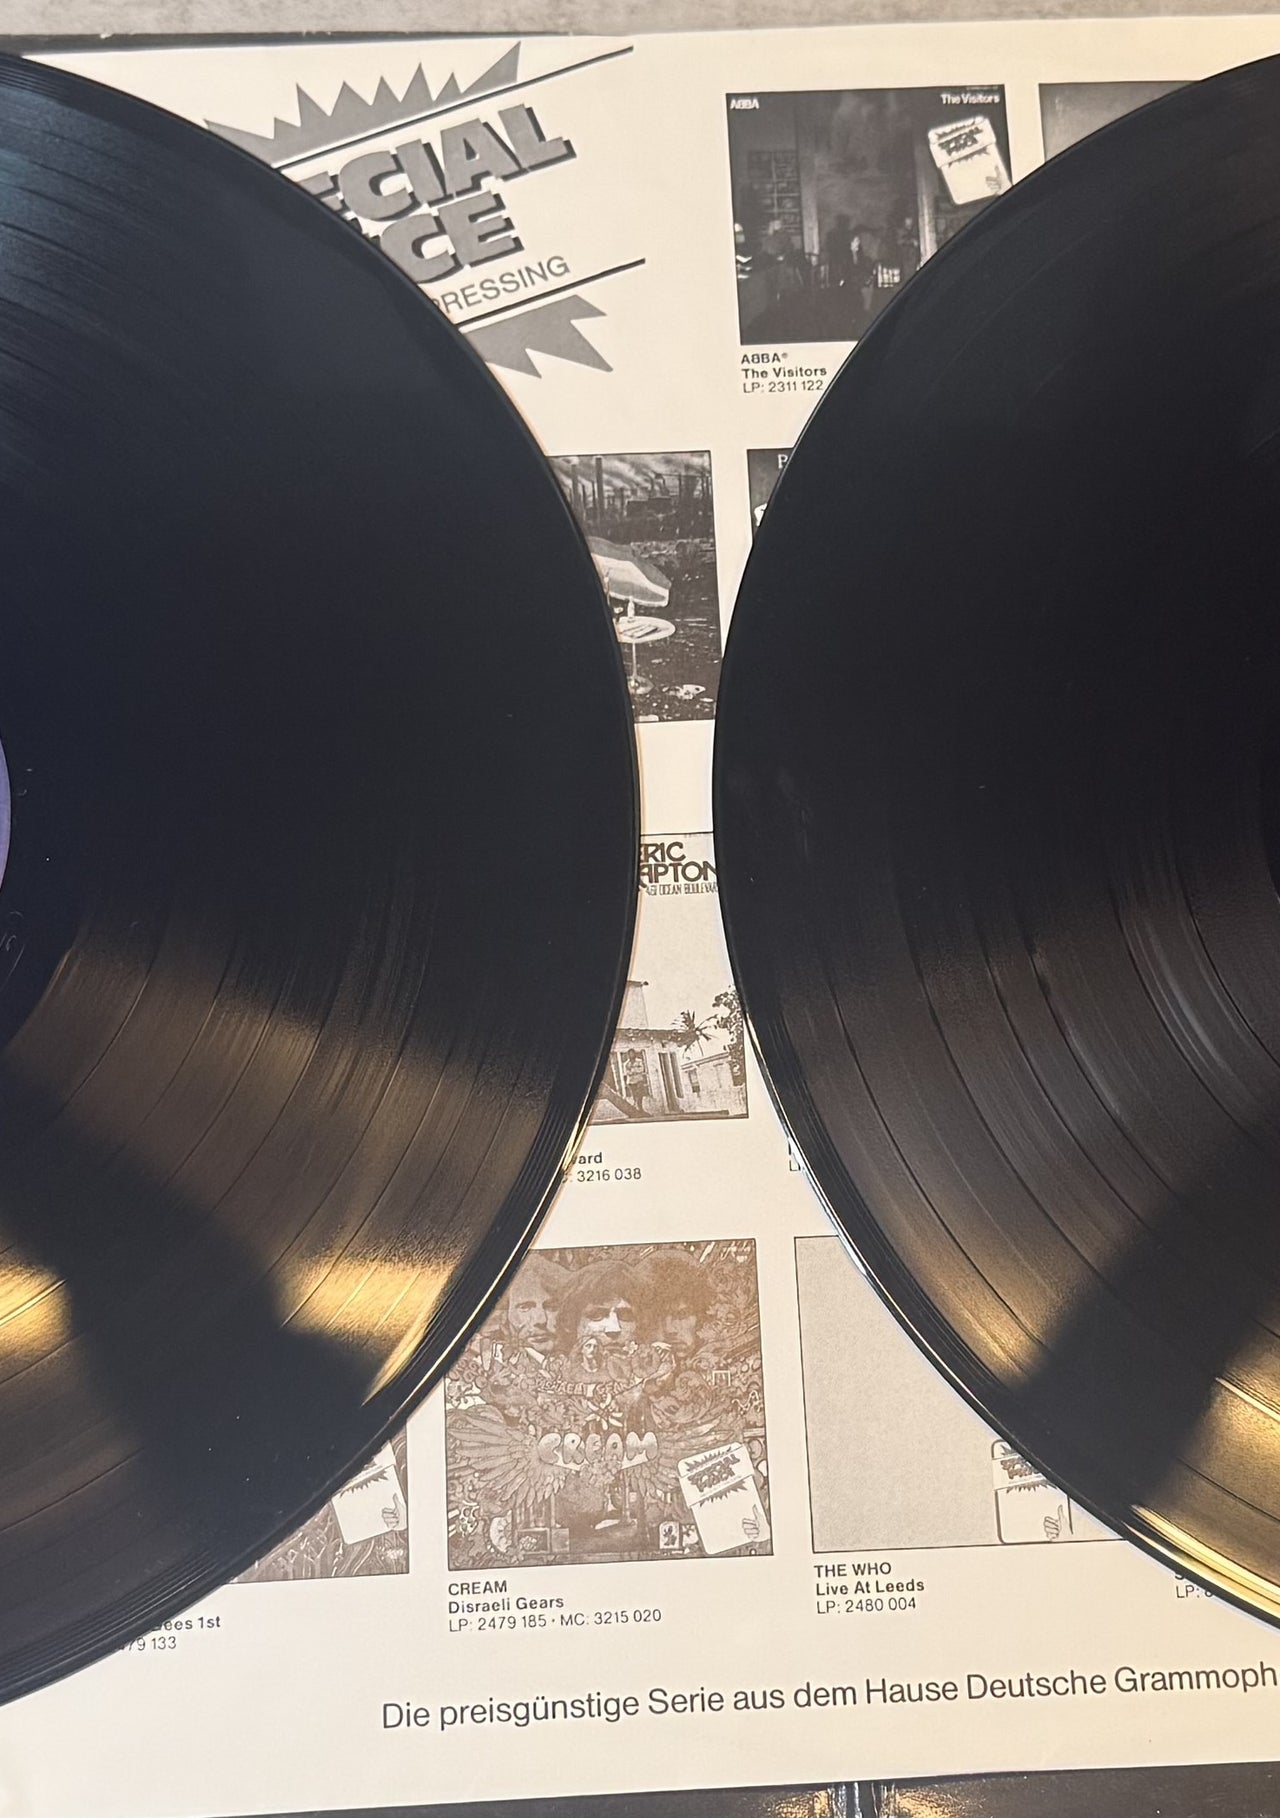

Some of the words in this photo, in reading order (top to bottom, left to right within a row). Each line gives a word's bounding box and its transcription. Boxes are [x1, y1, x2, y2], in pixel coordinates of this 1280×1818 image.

[730, 98, 760, 110] ABBA
[431, 255, 571, 314] RESSING
[741, 368, 768, 379] The
[772, 367, 827, 378] Visitors
[743, 382, 765, 393] LP:
[768, 381, 797, 393] 2311
[802, 380, 824, 391] 122
[577, 1169, 611, 1183] 3216
[614, 1167, 642, 1181] 038
[538, 1431, 659, 1466] CREAM
[813, 1563, 847, 1578] THE
[851, 1562, 892, 1576] WHO
[448, 1580, 507, 1596] CREAM
[816, 1583, 849, 1596] Live
[854, 1580, 871, 1595] At
[875, 1578, 925, 1593] Leeds
[1176, 1584, 1200, 1599] LP:
[448, 1598, 510, 1614] Disraeli
[515, 1597, 564, 1610] Gears
[816, 1600, 840, 1614] LP:
[845, 1598, 884, 1613] 2480
[888, 1597, 916, 1611] 004
[153, 1620, 193, 1632] ees
[198, 1615, 221, 1629] 1st
[449, 1618, 472, 1633] LP:
[478, 1615, 517, 1631] 2479
[522, 1614, 547, 1628] 185
[560, 1613, 590, 1627] MC:
[594, 1610, 629, 1625] 3215
[633, 1609, 662, 1623] 020
[151, 1636, 177, 1650] 133
[383, 1702, 430, 1729] Die
[440, 1691, 640, 1732] preisgünstige
[648, 1686, 724, 1715] Serie
[733, 1689, 785, 1711] aus
[793, 1682, 857, 1708] dem
[866, 1678, 958, 1705] Hause
[966, 1669, 1107, 1700] Deutsche
